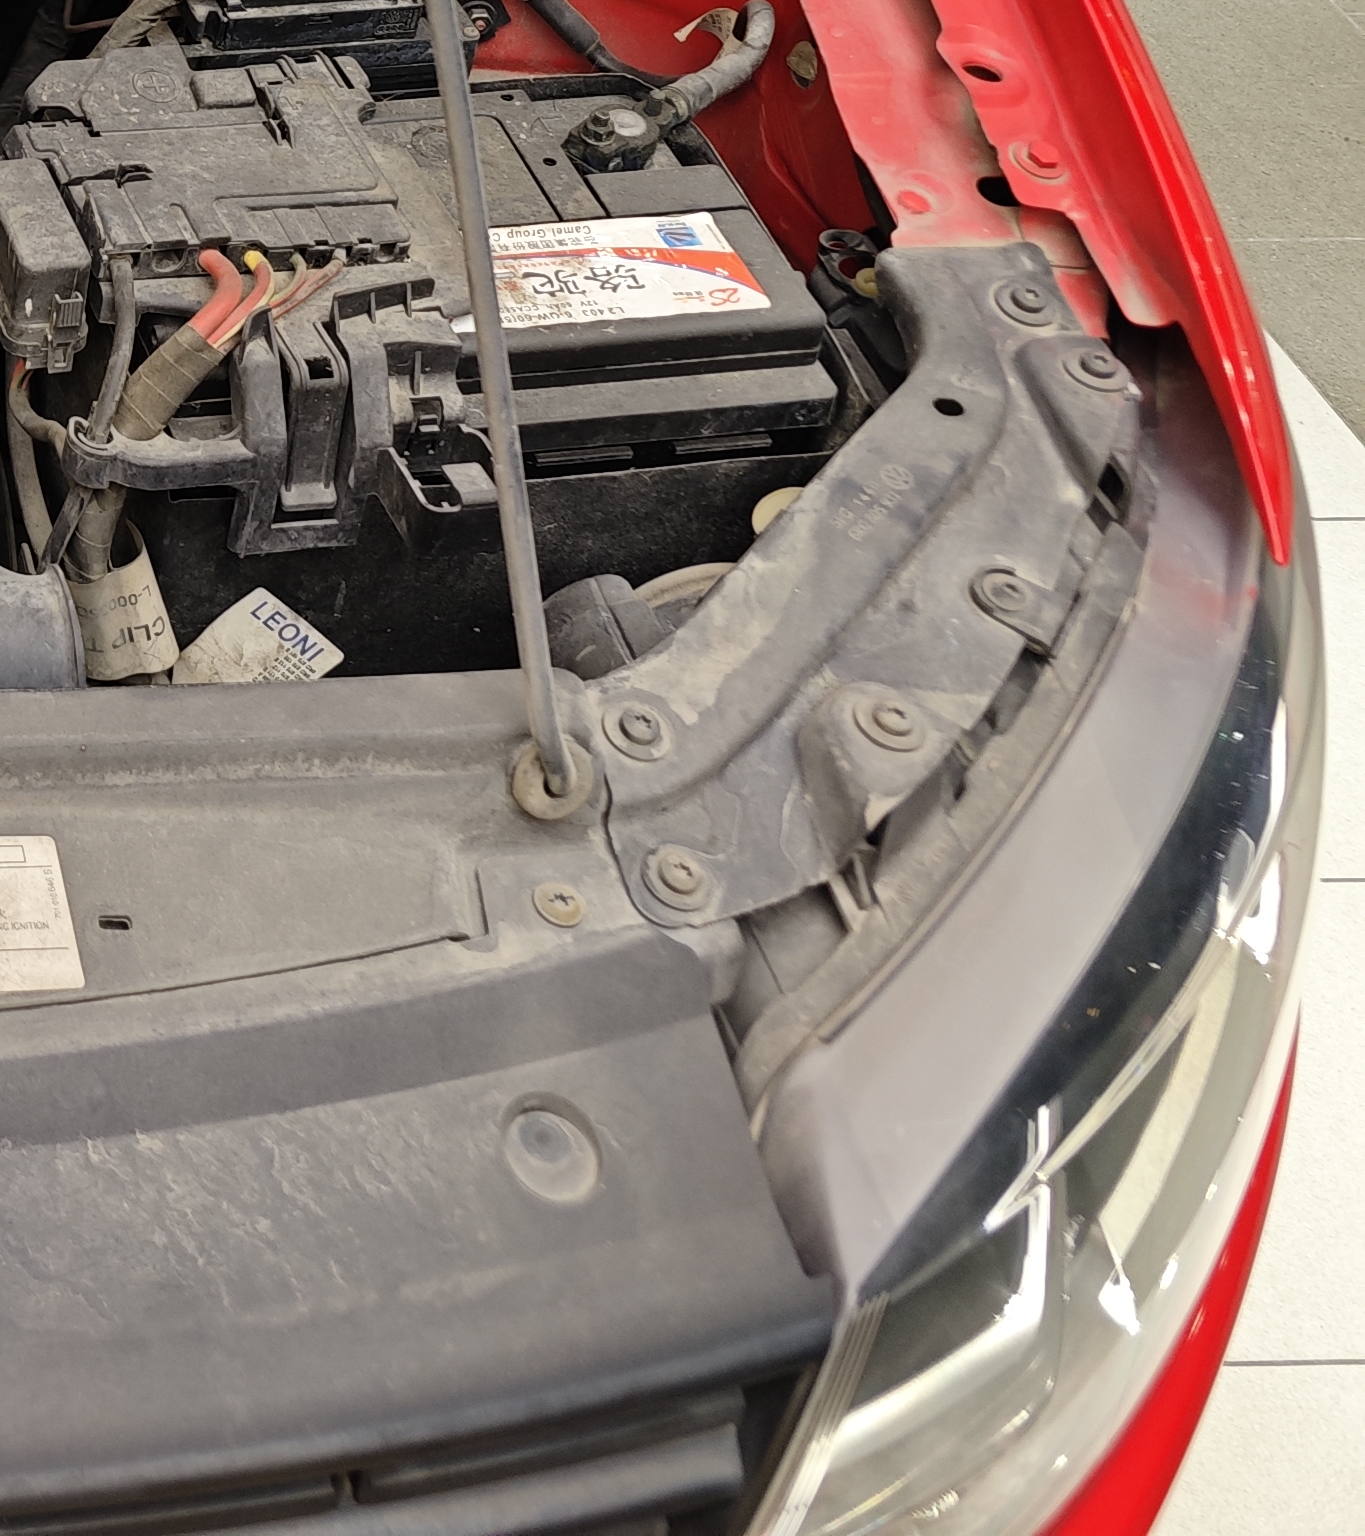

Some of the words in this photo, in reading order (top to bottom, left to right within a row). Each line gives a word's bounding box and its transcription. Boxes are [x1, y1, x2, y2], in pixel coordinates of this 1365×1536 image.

[506, 227, 547, 240] Group
[552, 225, 591, 236] Camel
[522, 264, 646, 297] 骆驼
[581, 299, 598, 308] 12V
[113, 615, 166, 650] CLIP
[249, 600, 325, 663] LEONI
[11, 920, 50, 930] IGNITION
